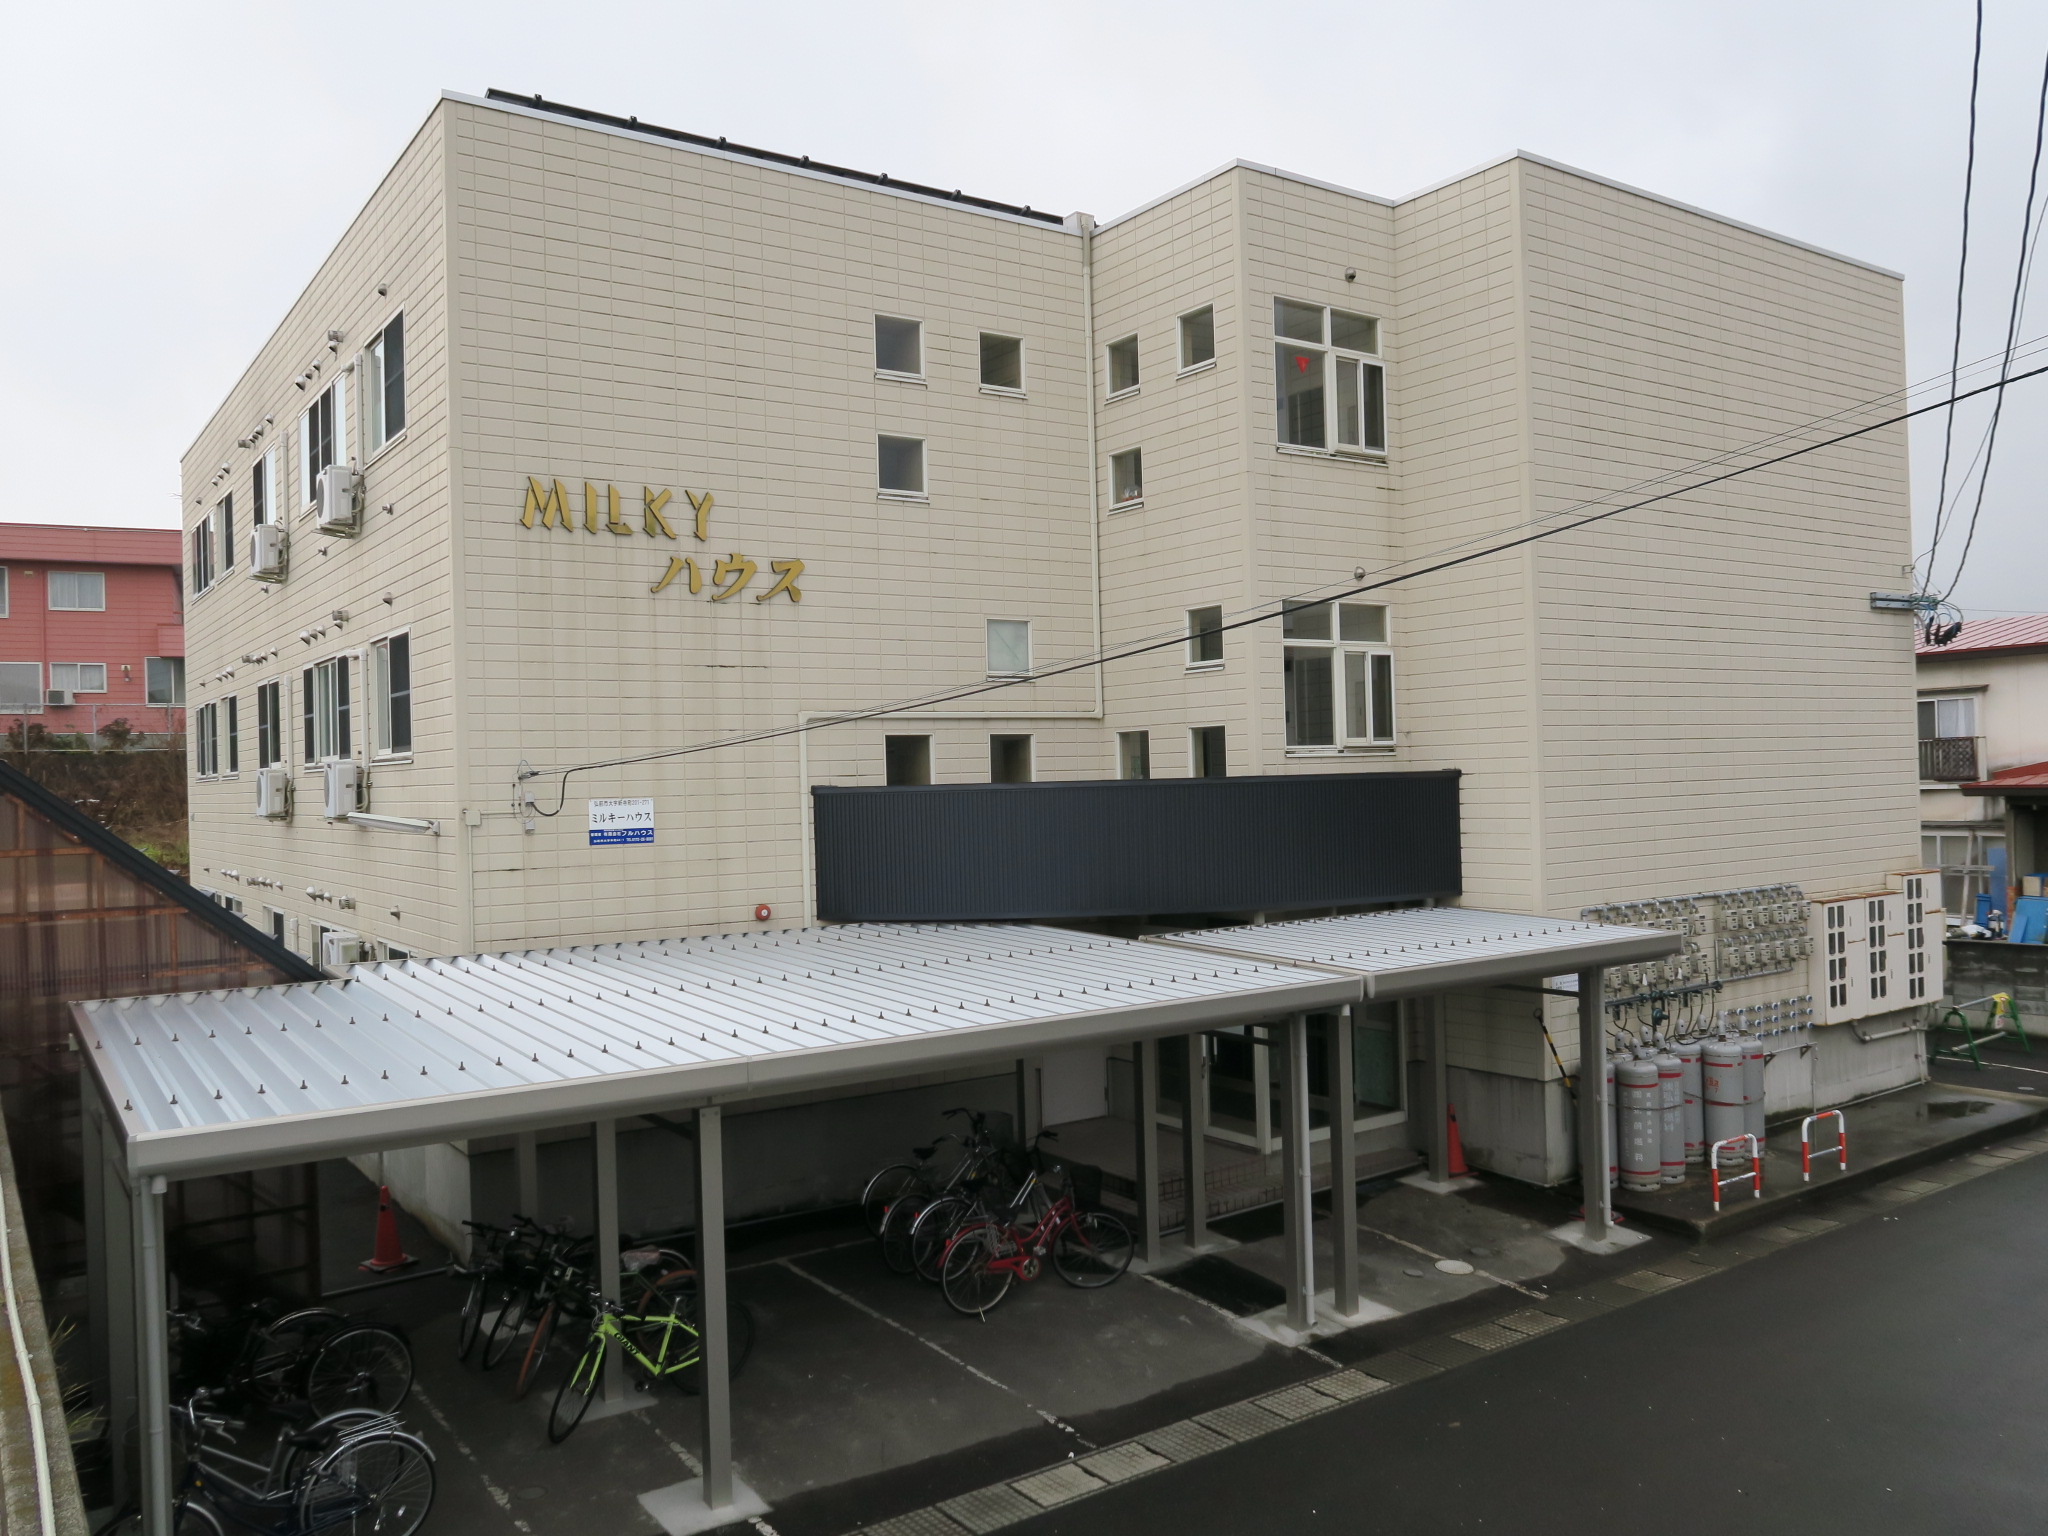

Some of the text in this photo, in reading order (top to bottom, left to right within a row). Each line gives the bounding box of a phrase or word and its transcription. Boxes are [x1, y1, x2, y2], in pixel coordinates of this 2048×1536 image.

[520, 475, 715, 541] MILKY
[651, 552, 806, 602] ハウス
[592, 812, 651, 823] ミルキーハウス
[614, 1332, 639, 1355] GIANT
